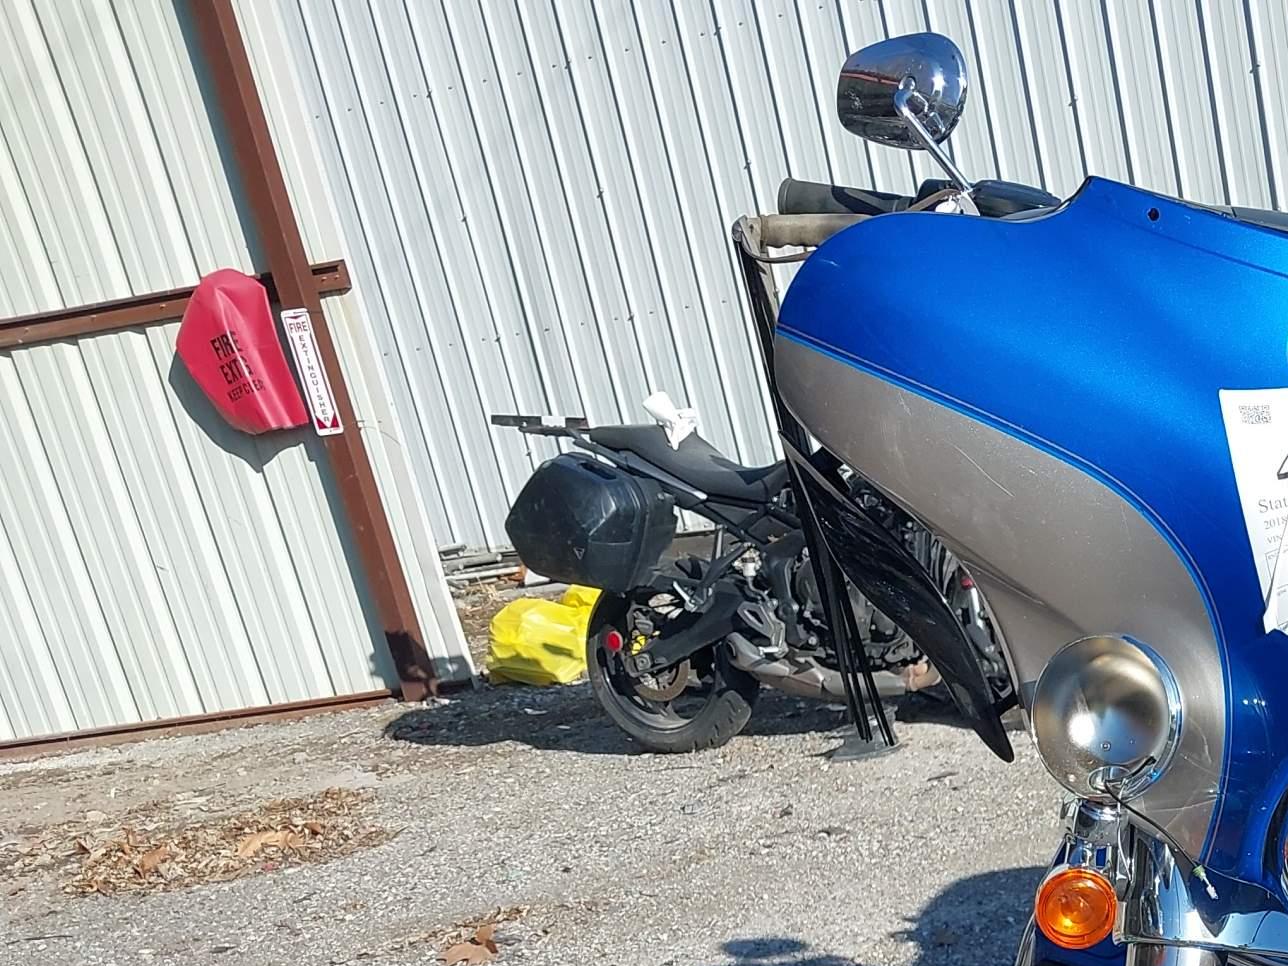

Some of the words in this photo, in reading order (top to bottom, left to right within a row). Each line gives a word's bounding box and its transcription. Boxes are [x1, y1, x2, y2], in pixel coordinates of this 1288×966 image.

[289, 321, 308, 334] FIRE
[210, 330, 243, 360] FIRE
[299, 335, 330, 422] EXTINGUISHER
